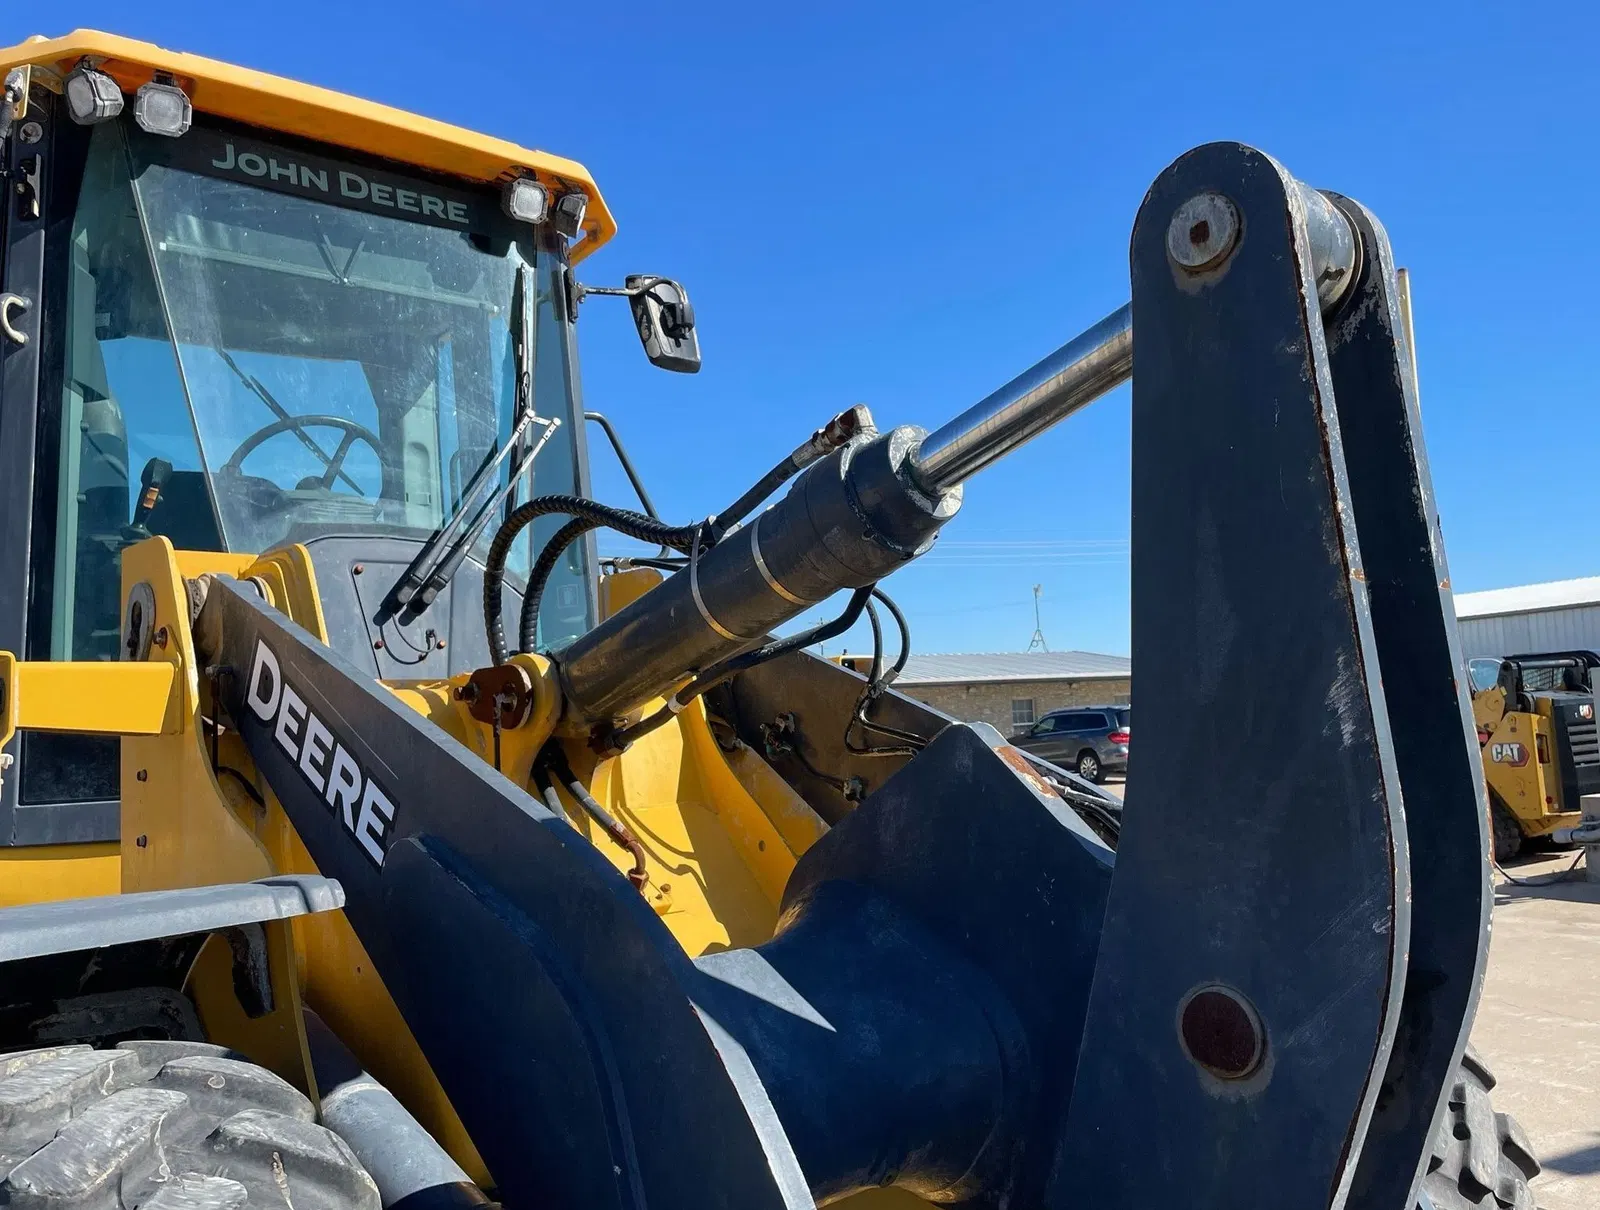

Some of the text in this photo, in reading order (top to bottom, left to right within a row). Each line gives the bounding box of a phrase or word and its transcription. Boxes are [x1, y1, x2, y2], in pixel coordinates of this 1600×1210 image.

[212, 143, 469, 224] JOHN DEERE
[247, 638, 395, 867] DEERE
[1491, 743, 1520, 762] CAT
